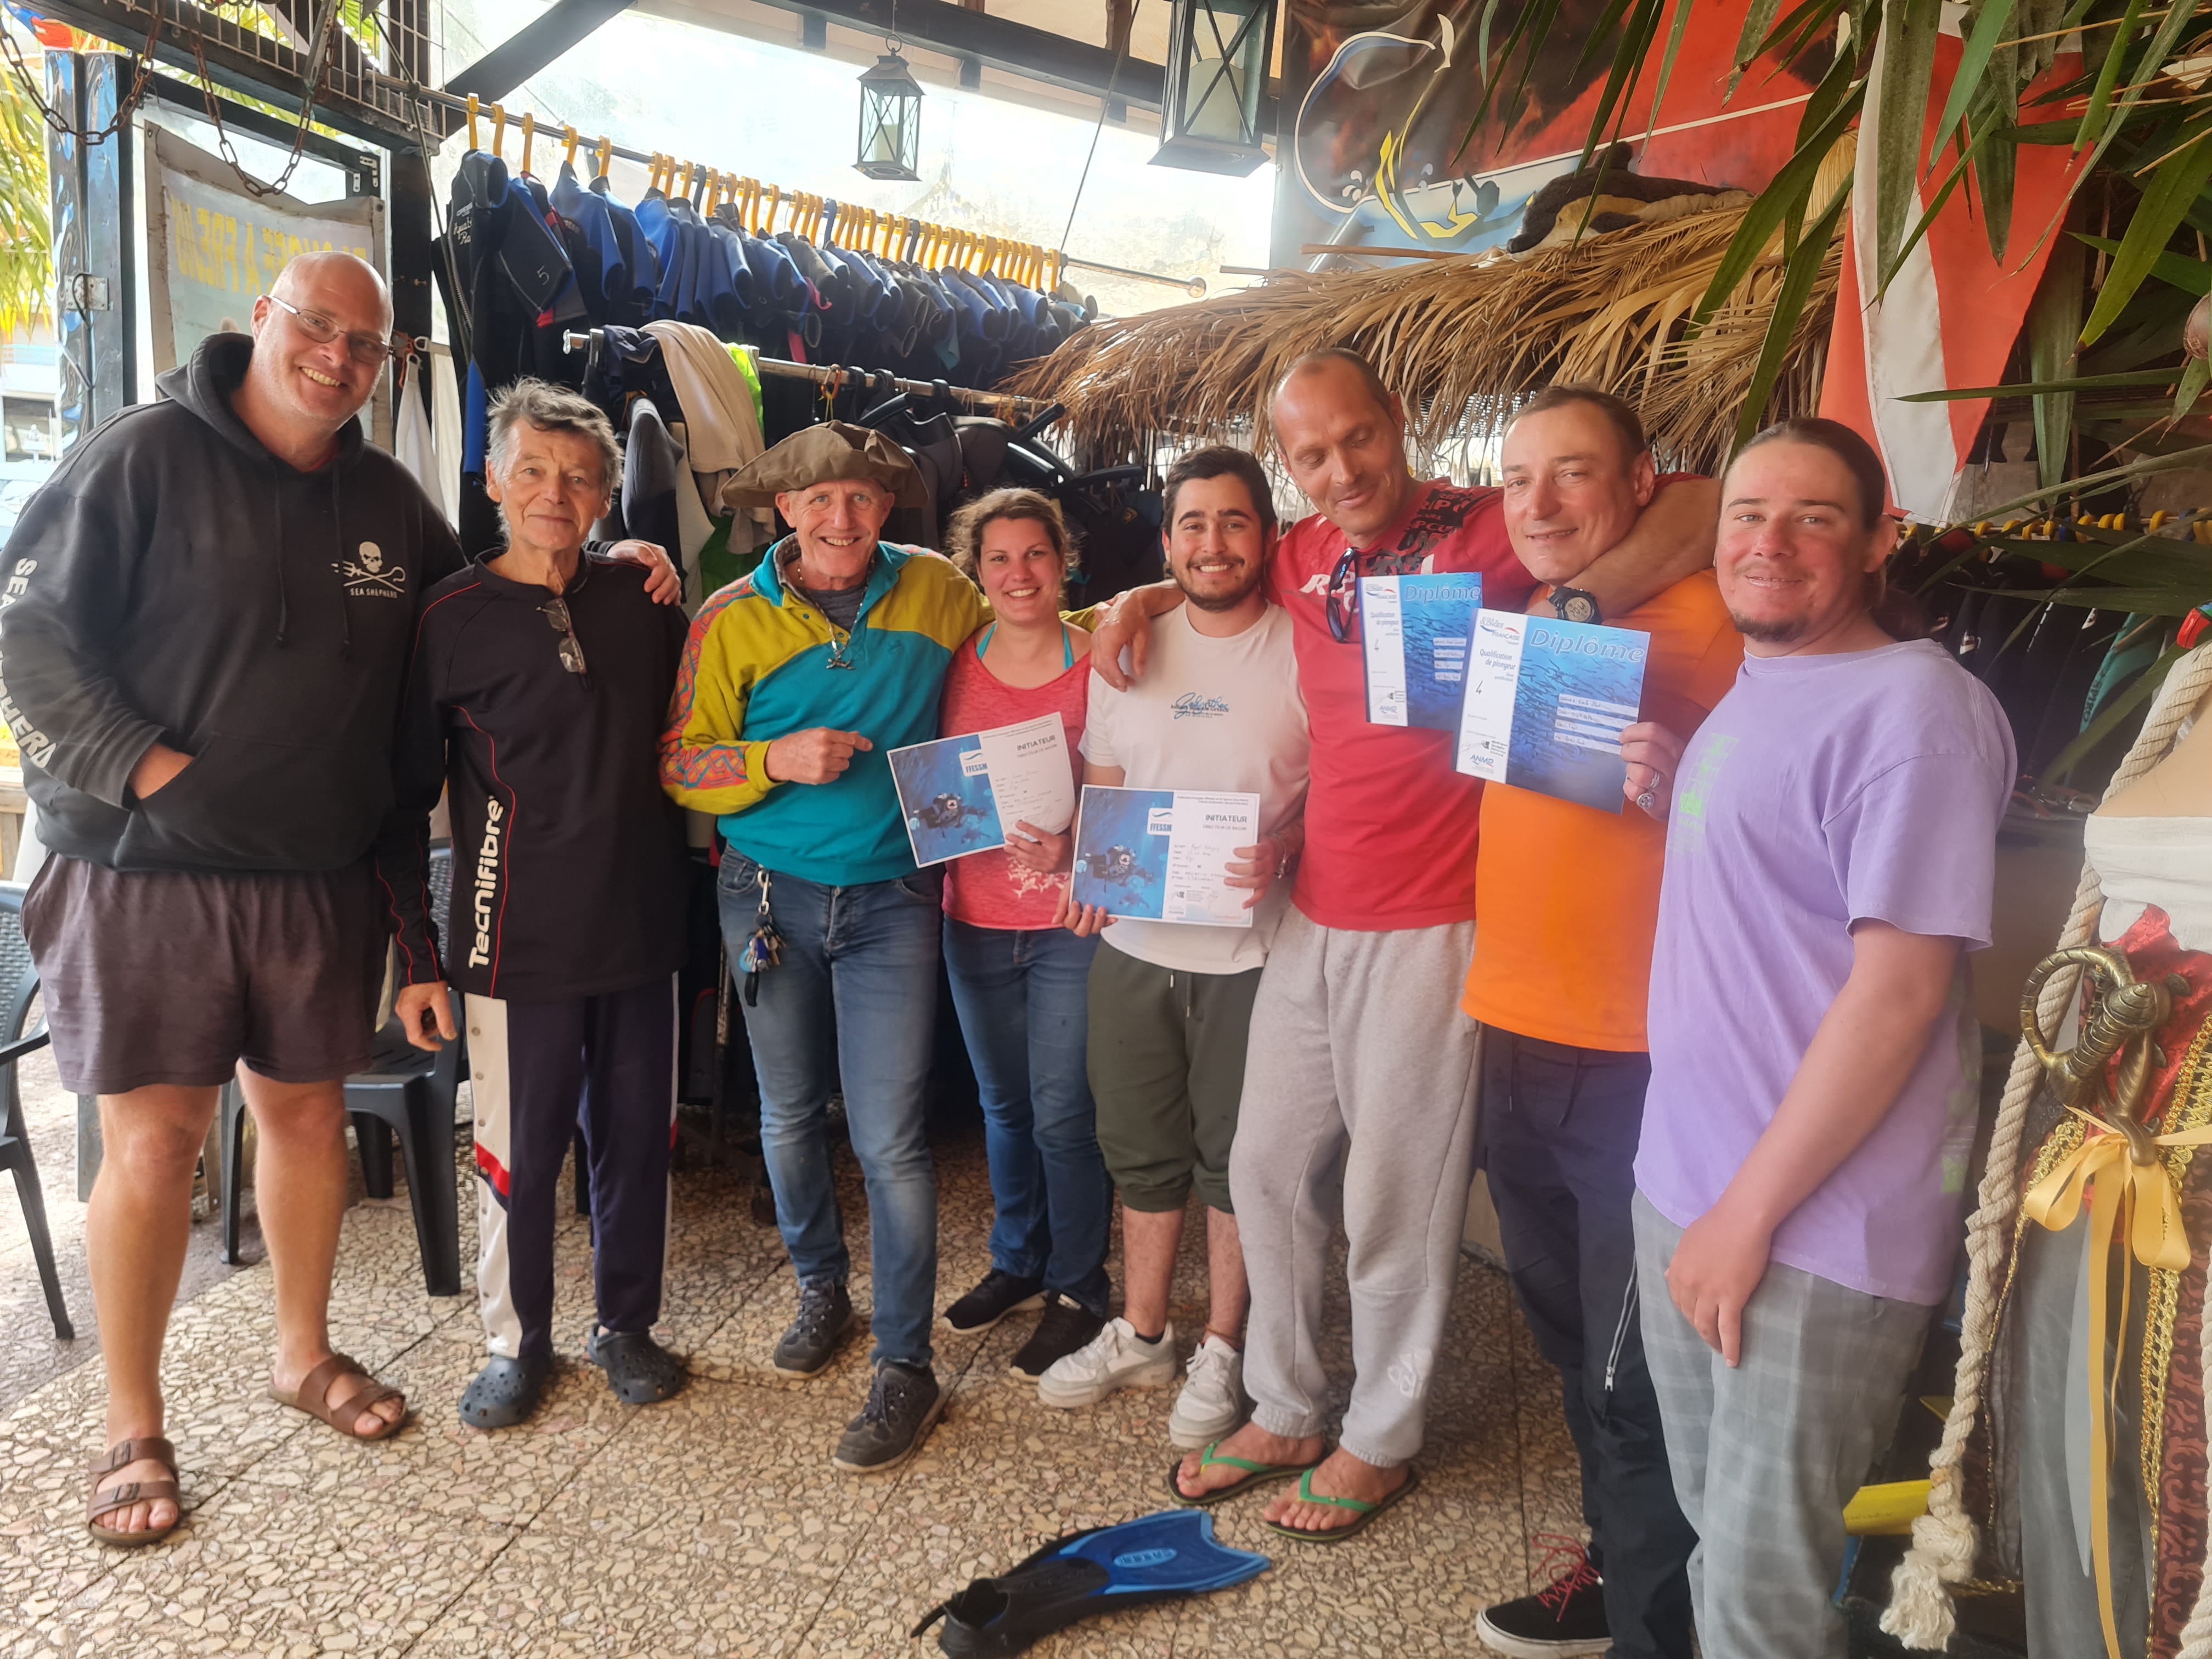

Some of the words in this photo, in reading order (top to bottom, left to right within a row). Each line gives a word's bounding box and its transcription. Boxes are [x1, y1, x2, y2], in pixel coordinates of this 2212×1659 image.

[537, 266, 549, 286] 5
[1299, 569, 1356, 596] RP
[350, 588, 364, 596] SEA
[366, 588, 398, 599] SHEPHERD
[1405, 583, 1481, 605] Diplôme
[1530, 628, 1645, 663] Diplôme
[1480, 648, 1513, 660] Qualification
[1492, 660, 1516, 670] plongeur
[1476, 680, 1483, 695] 4
[1017, 735, 1056, 752] INITIATEUR
[1470, 754, 1494, 764] ANMP
[1205, 814, 1247, 823] INITIATEUR
